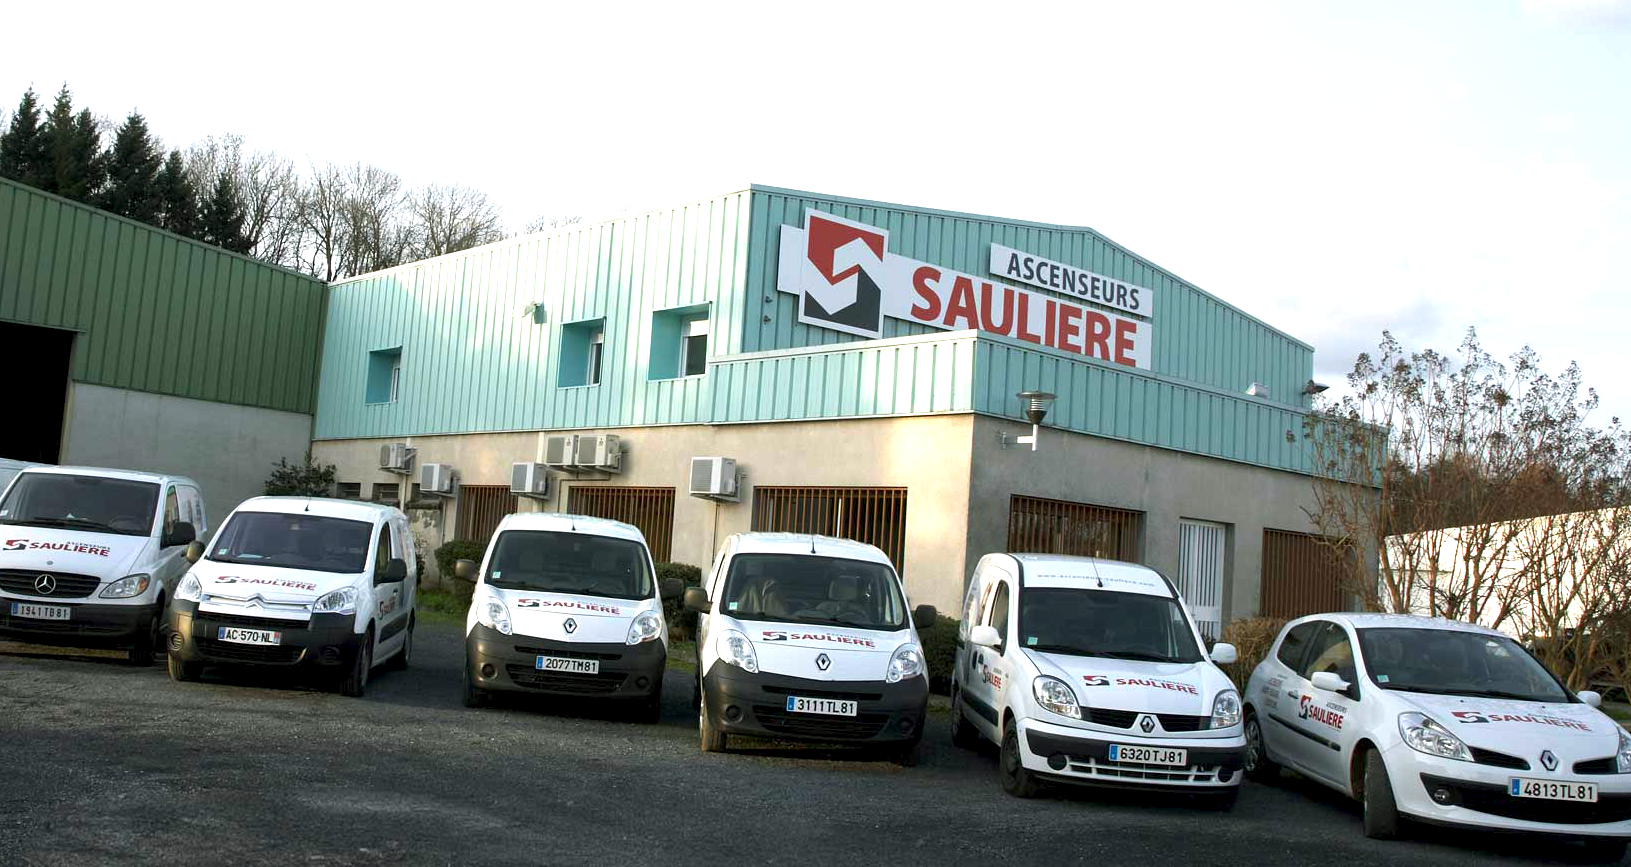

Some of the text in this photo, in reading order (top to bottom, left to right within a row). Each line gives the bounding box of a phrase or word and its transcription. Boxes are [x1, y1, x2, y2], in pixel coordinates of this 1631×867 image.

[1007, 252, 1140, 310] ASCENSEURS
[910, 266, 1137, 368] SAULIERE
[29, 542, 111, 557] SAULIERE
[240, 578, 317, 591] SAULIERE
[543, 601, 621, 615] SAULIERE
[790, 633, 876, 648] SAULIERE
[1116, 678, 1199, 695] SAULIERE
[1308, 704, 1344, 730] SAULIERE
[1488, 714, 1592, 732] SAULIERE
